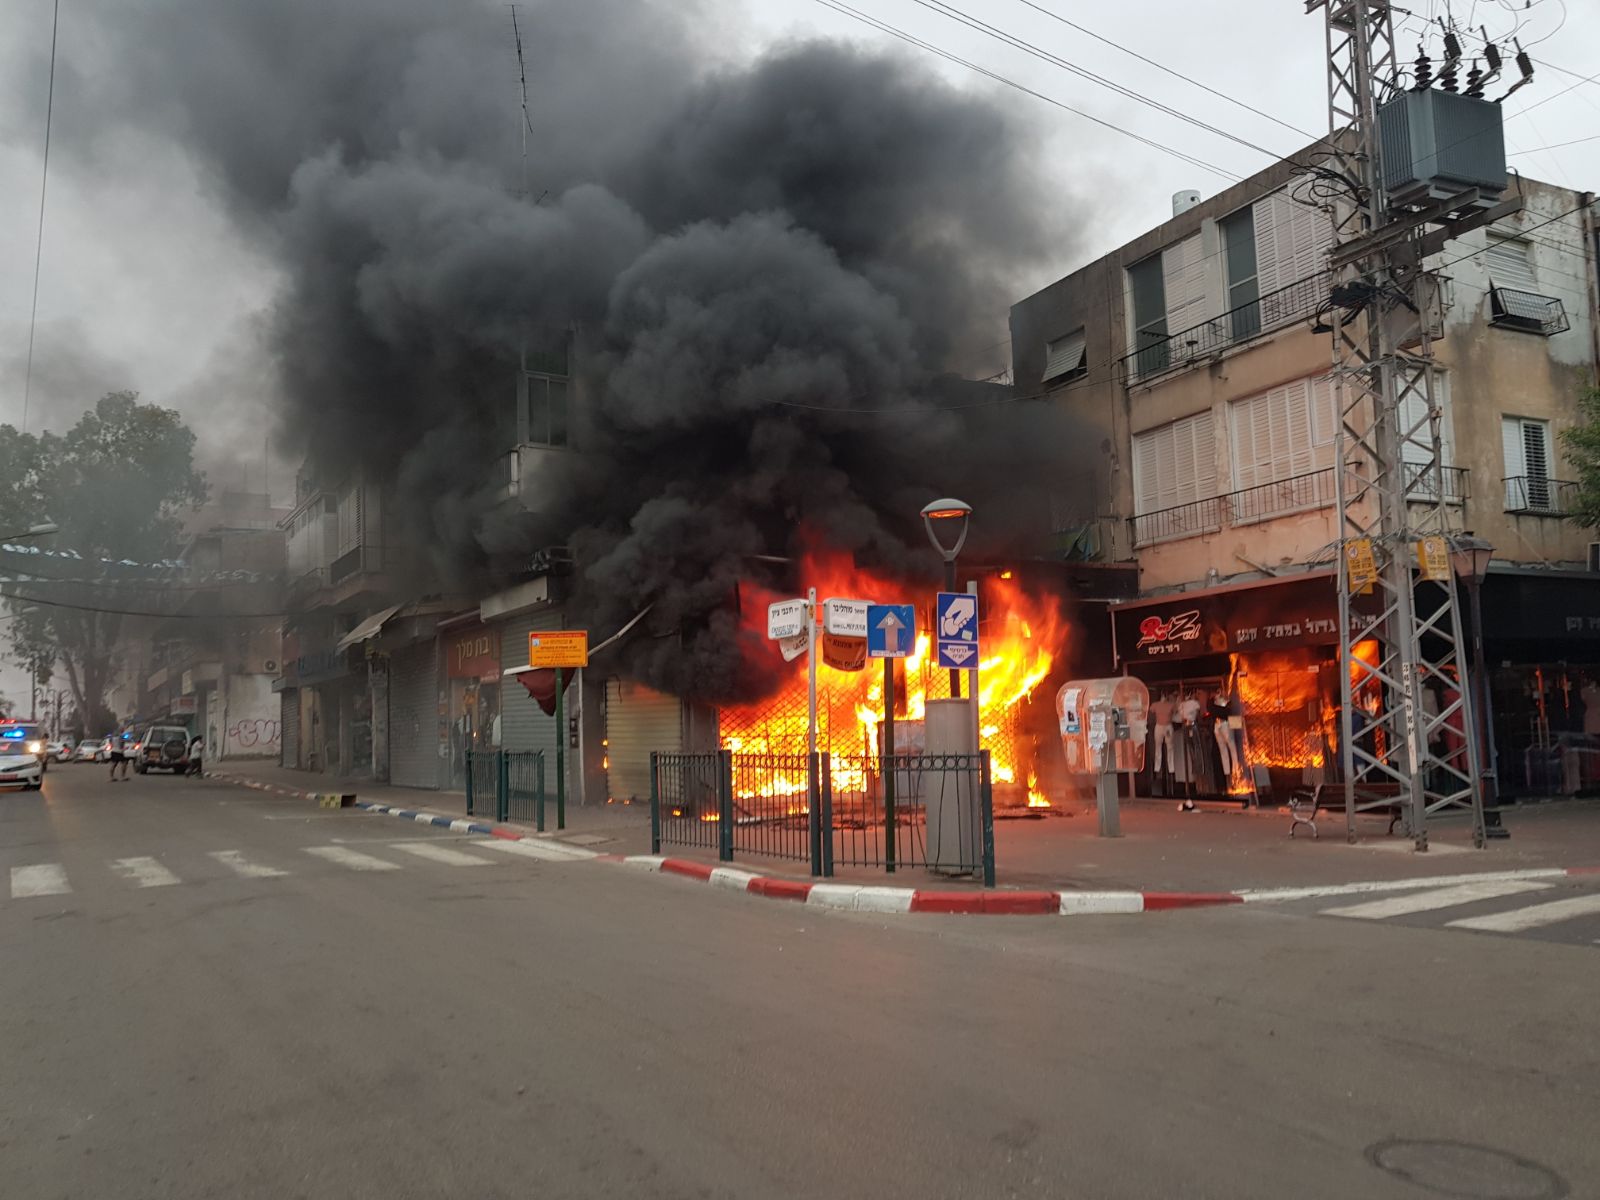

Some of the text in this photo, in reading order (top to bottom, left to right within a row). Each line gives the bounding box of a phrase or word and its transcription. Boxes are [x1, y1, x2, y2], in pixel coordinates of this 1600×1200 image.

[771, 609, 780, 619] ציון
[833, 604, 853, 614] מוהליבר
[1305, 618, 1337, 633] גדול
[456, 637, 489, 671] בת מלך
